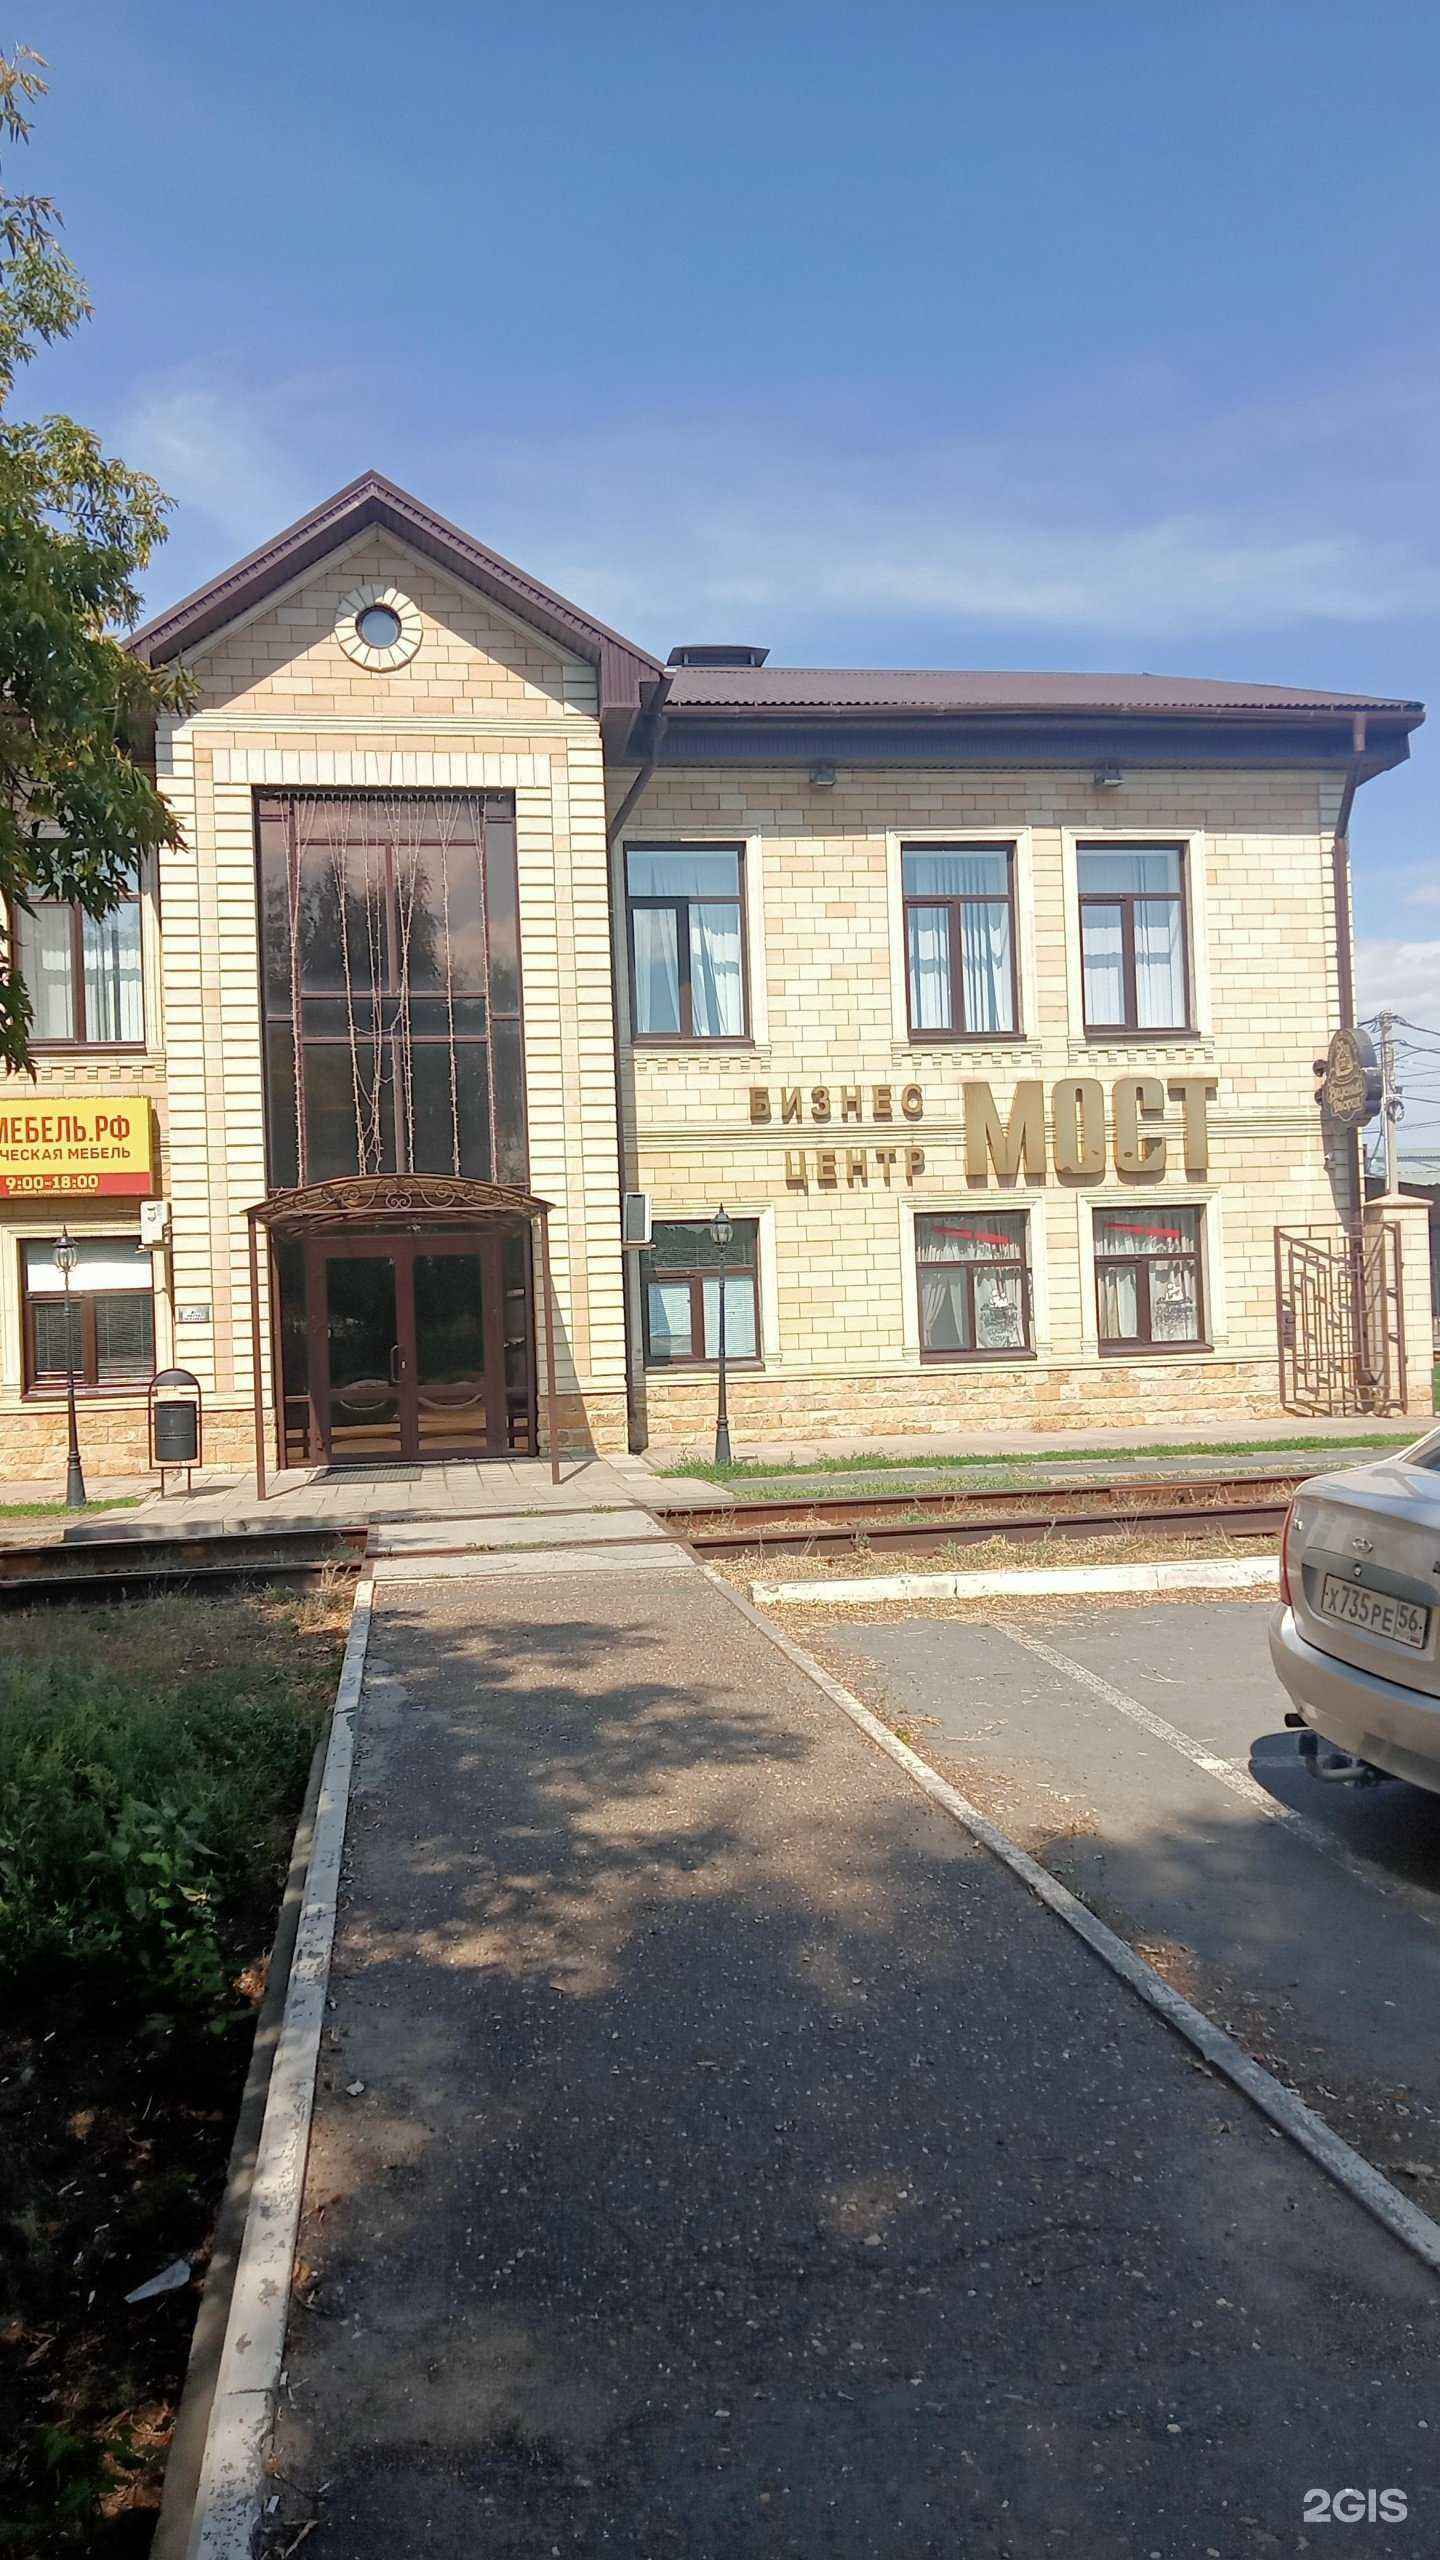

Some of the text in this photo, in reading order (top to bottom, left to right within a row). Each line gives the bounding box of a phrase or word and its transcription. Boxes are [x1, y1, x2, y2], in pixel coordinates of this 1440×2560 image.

[750, 1083, 923, 1118] БИЗНЕС
[963, 1077, 1218, 1175] МОСТ
[67, 1147, 131, 1160] МЕБЕЛЬ
[785, 1148, 925, 1188] ЦЕНТР
[6, 1174, 99, 1190] 9:00-18:00
